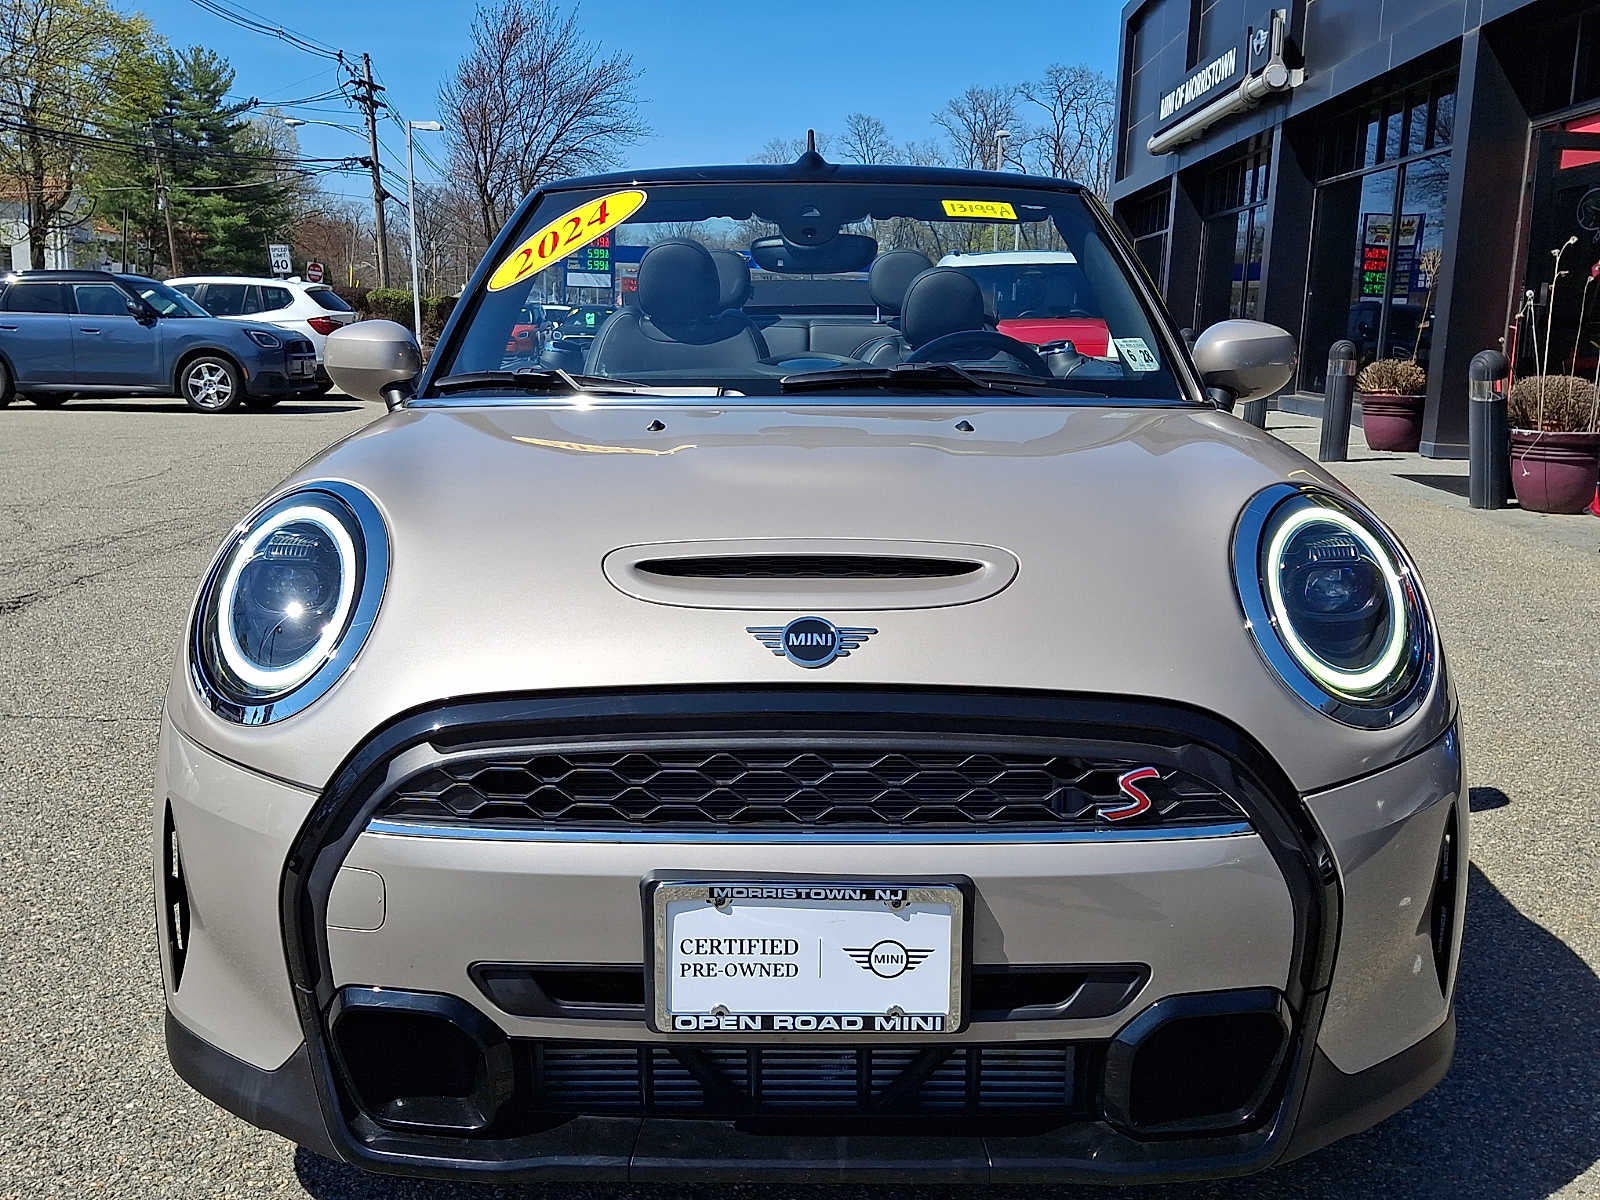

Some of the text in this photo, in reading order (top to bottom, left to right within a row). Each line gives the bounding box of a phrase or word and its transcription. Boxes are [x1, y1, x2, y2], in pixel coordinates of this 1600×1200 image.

[1175, 83, 1185, 111] OF
[1185, 47, 1237, 105] MORRISTOWN
[514, 200, 609, 279] 2024
[273, 259, 288, 270] 40
[1126, 348, 1154, 363] 6 28
[788, 632, 832, 646] MINI
[1097, 766, 1161, 822] S
[713, 887, 903, 900] MORRISTOWN, NJ
[679, 938, 799, 955] CERTIFIED
[873, 954, 904, 965] MINI
[679, 962, 799, 978] PRE-OWNED
[674, 1015, 942, 1031] OPEN ROAD MINI
